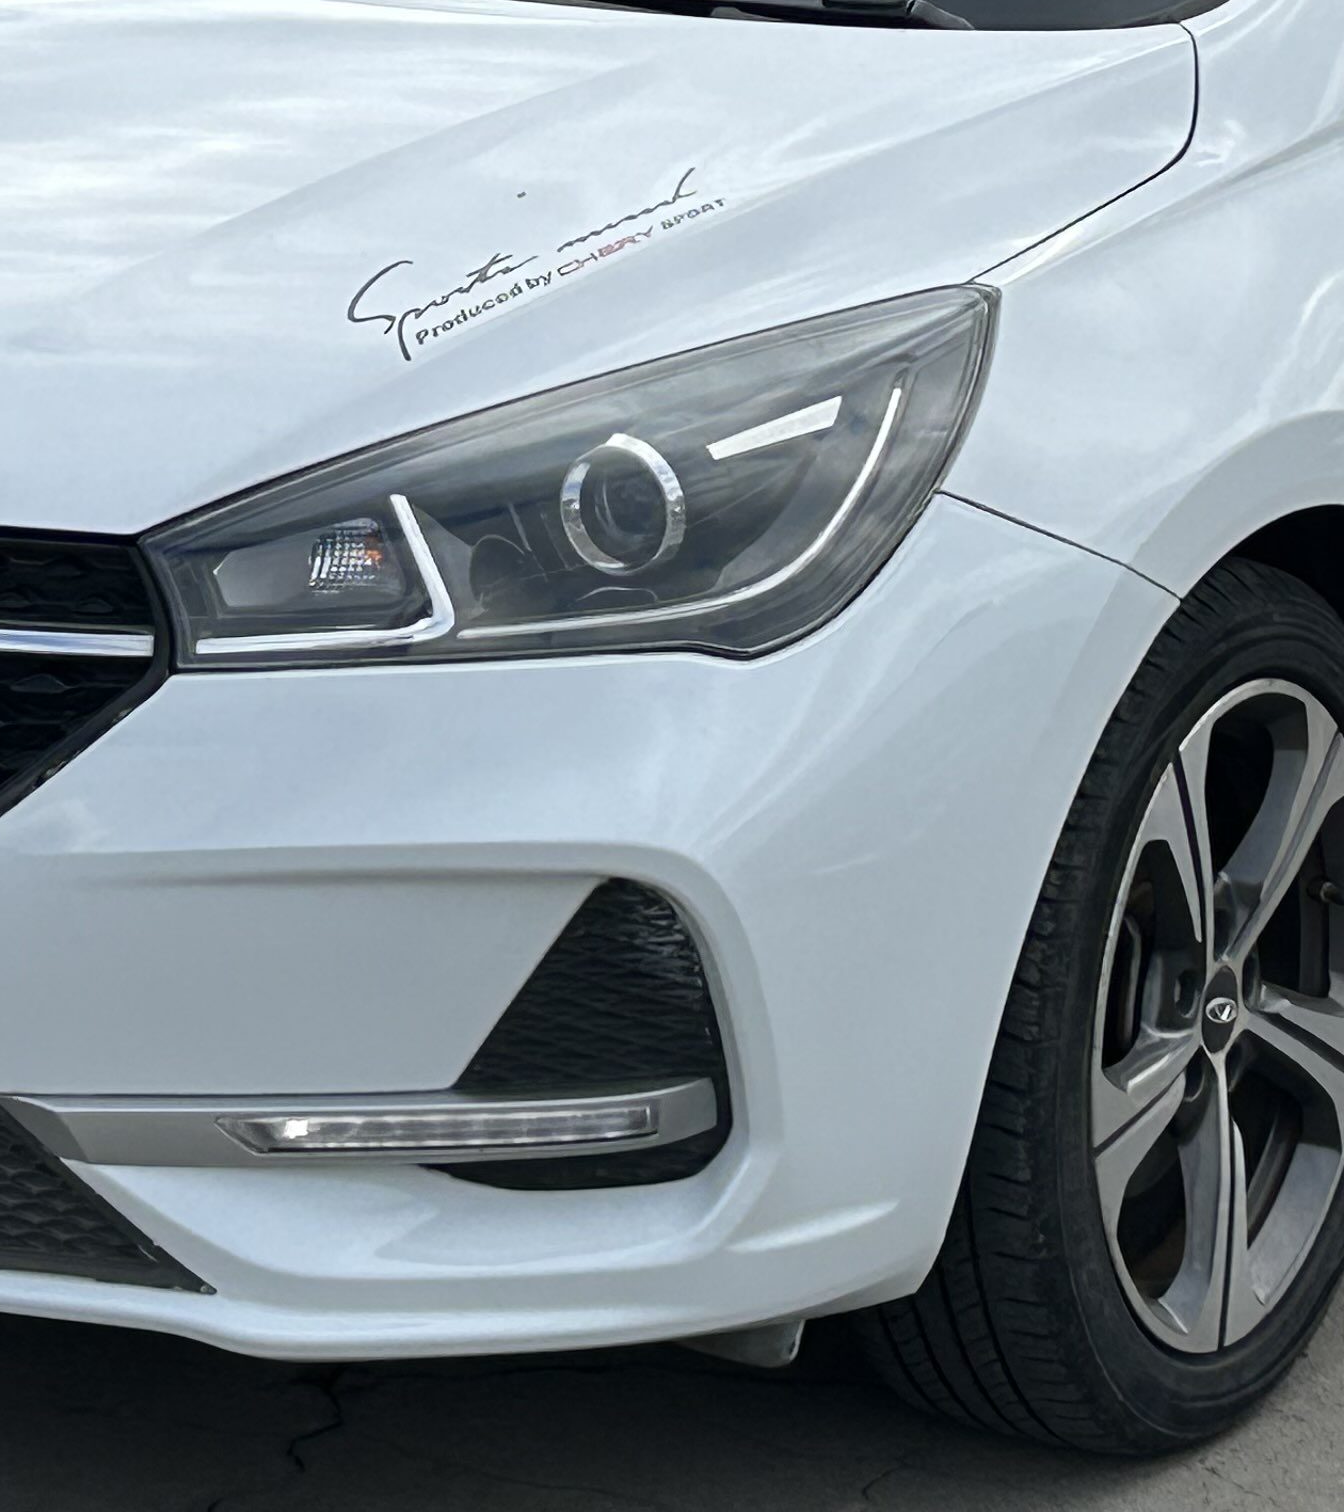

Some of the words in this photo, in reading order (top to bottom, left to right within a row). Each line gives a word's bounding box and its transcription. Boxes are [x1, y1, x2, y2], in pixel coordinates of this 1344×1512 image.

[415, 281, 523, 346] Produced
[525, 271, 553, 292] by
[556, 226, 654, 277] CHERY
[660, 198, 728, 231] SPORT
